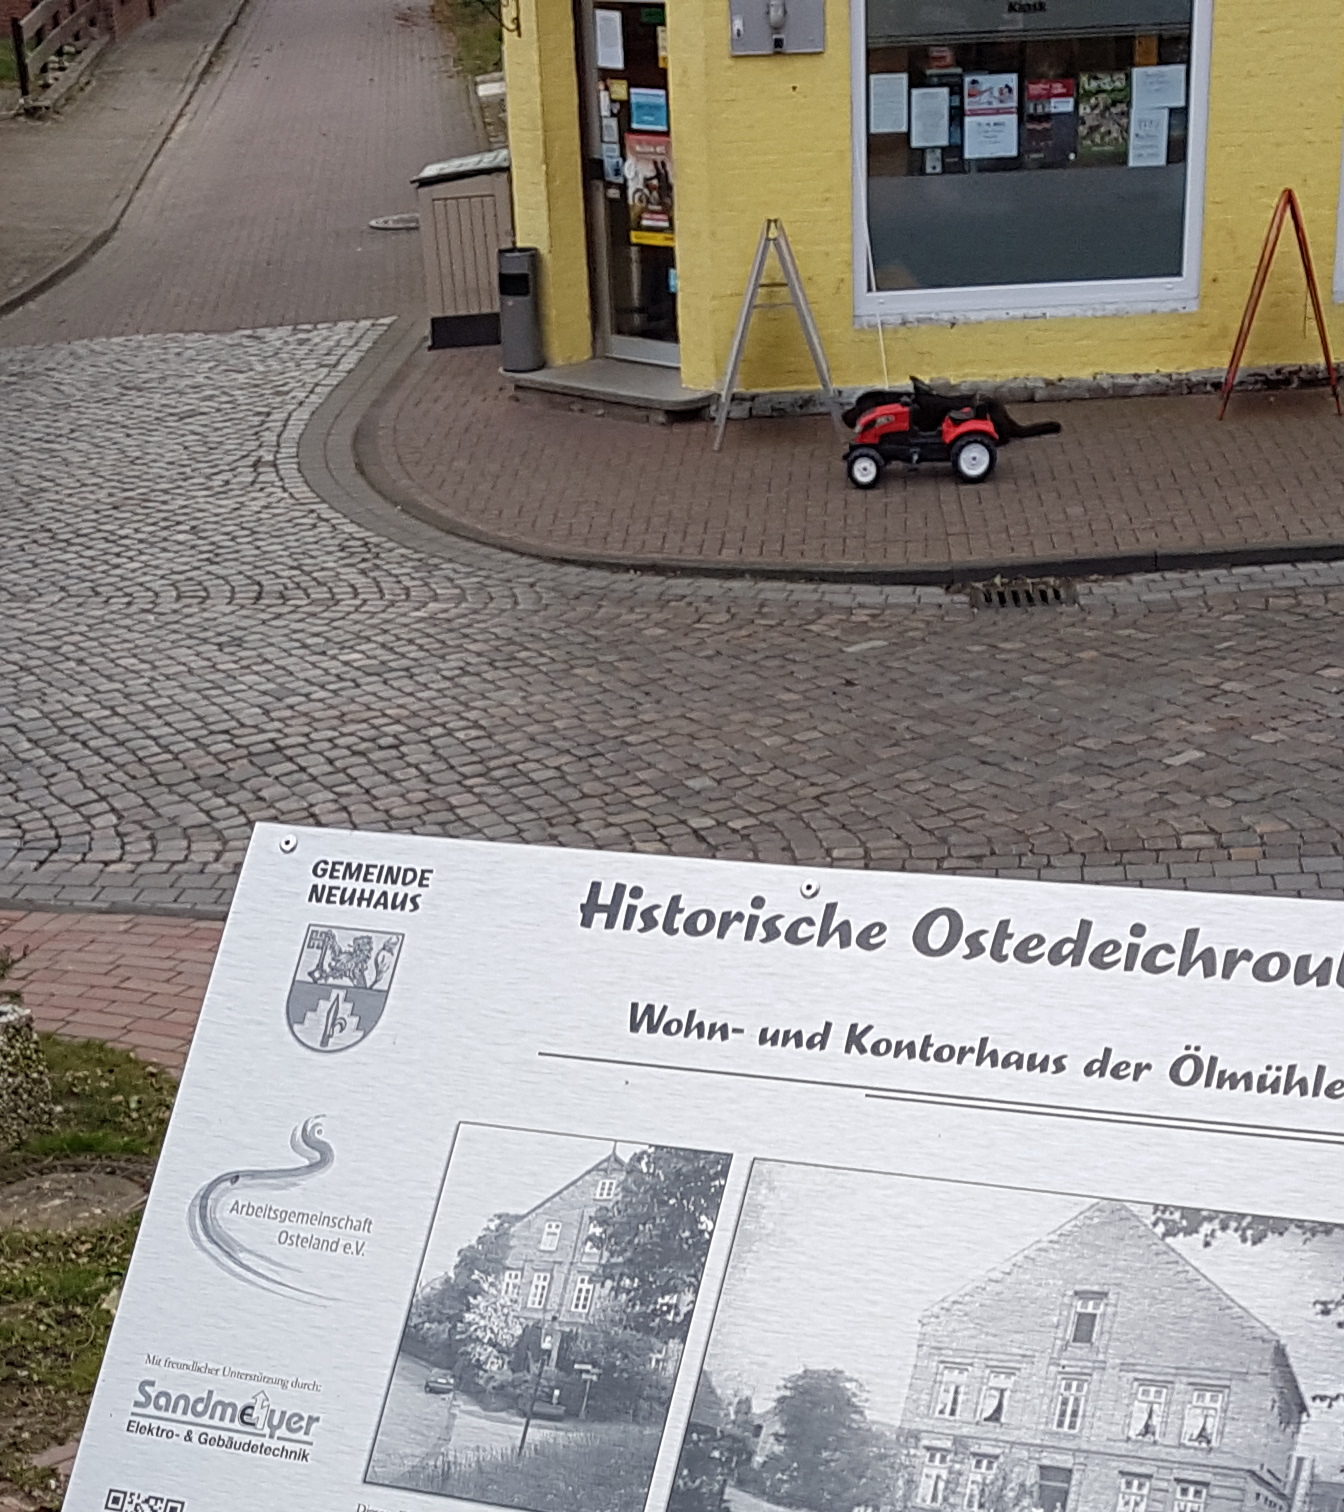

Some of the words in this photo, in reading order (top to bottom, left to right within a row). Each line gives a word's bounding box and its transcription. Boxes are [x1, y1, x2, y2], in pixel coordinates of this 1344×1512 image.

[311, 859, 434, 888] GEMEINDE
[307, 883, 422, 913] NEUHAUS
[579, 881, 888, 951] Historische
[629, 1001, 745, 1042] Wohn-
[758, 1020, 833, 1051] und
[844, 1022, 1068, 1075] Kontorhaus
[1083, 1046, 1153, 1082] der
[229, 1199, 373, 1234] Arbeitsgemeinschaft
[277, 1229, 341, 1253] Osteland
[342, 1240, 366, 1257] e.V.
[145, 1353, 162, 1367] Mit
[163, 1357, 221, 1376] freundlicher
[222, 1366, 290, 1390] Unterstützung
[290, 1377, 322, 1393] durch:
[133, 1380, 321, 1439] Sandmeyer
[125, 1419, 180, 1440] Elektro-
[183, 1429, 193, 1443] &
[197, 1431, 310, 1463] Gebäudetechnik
